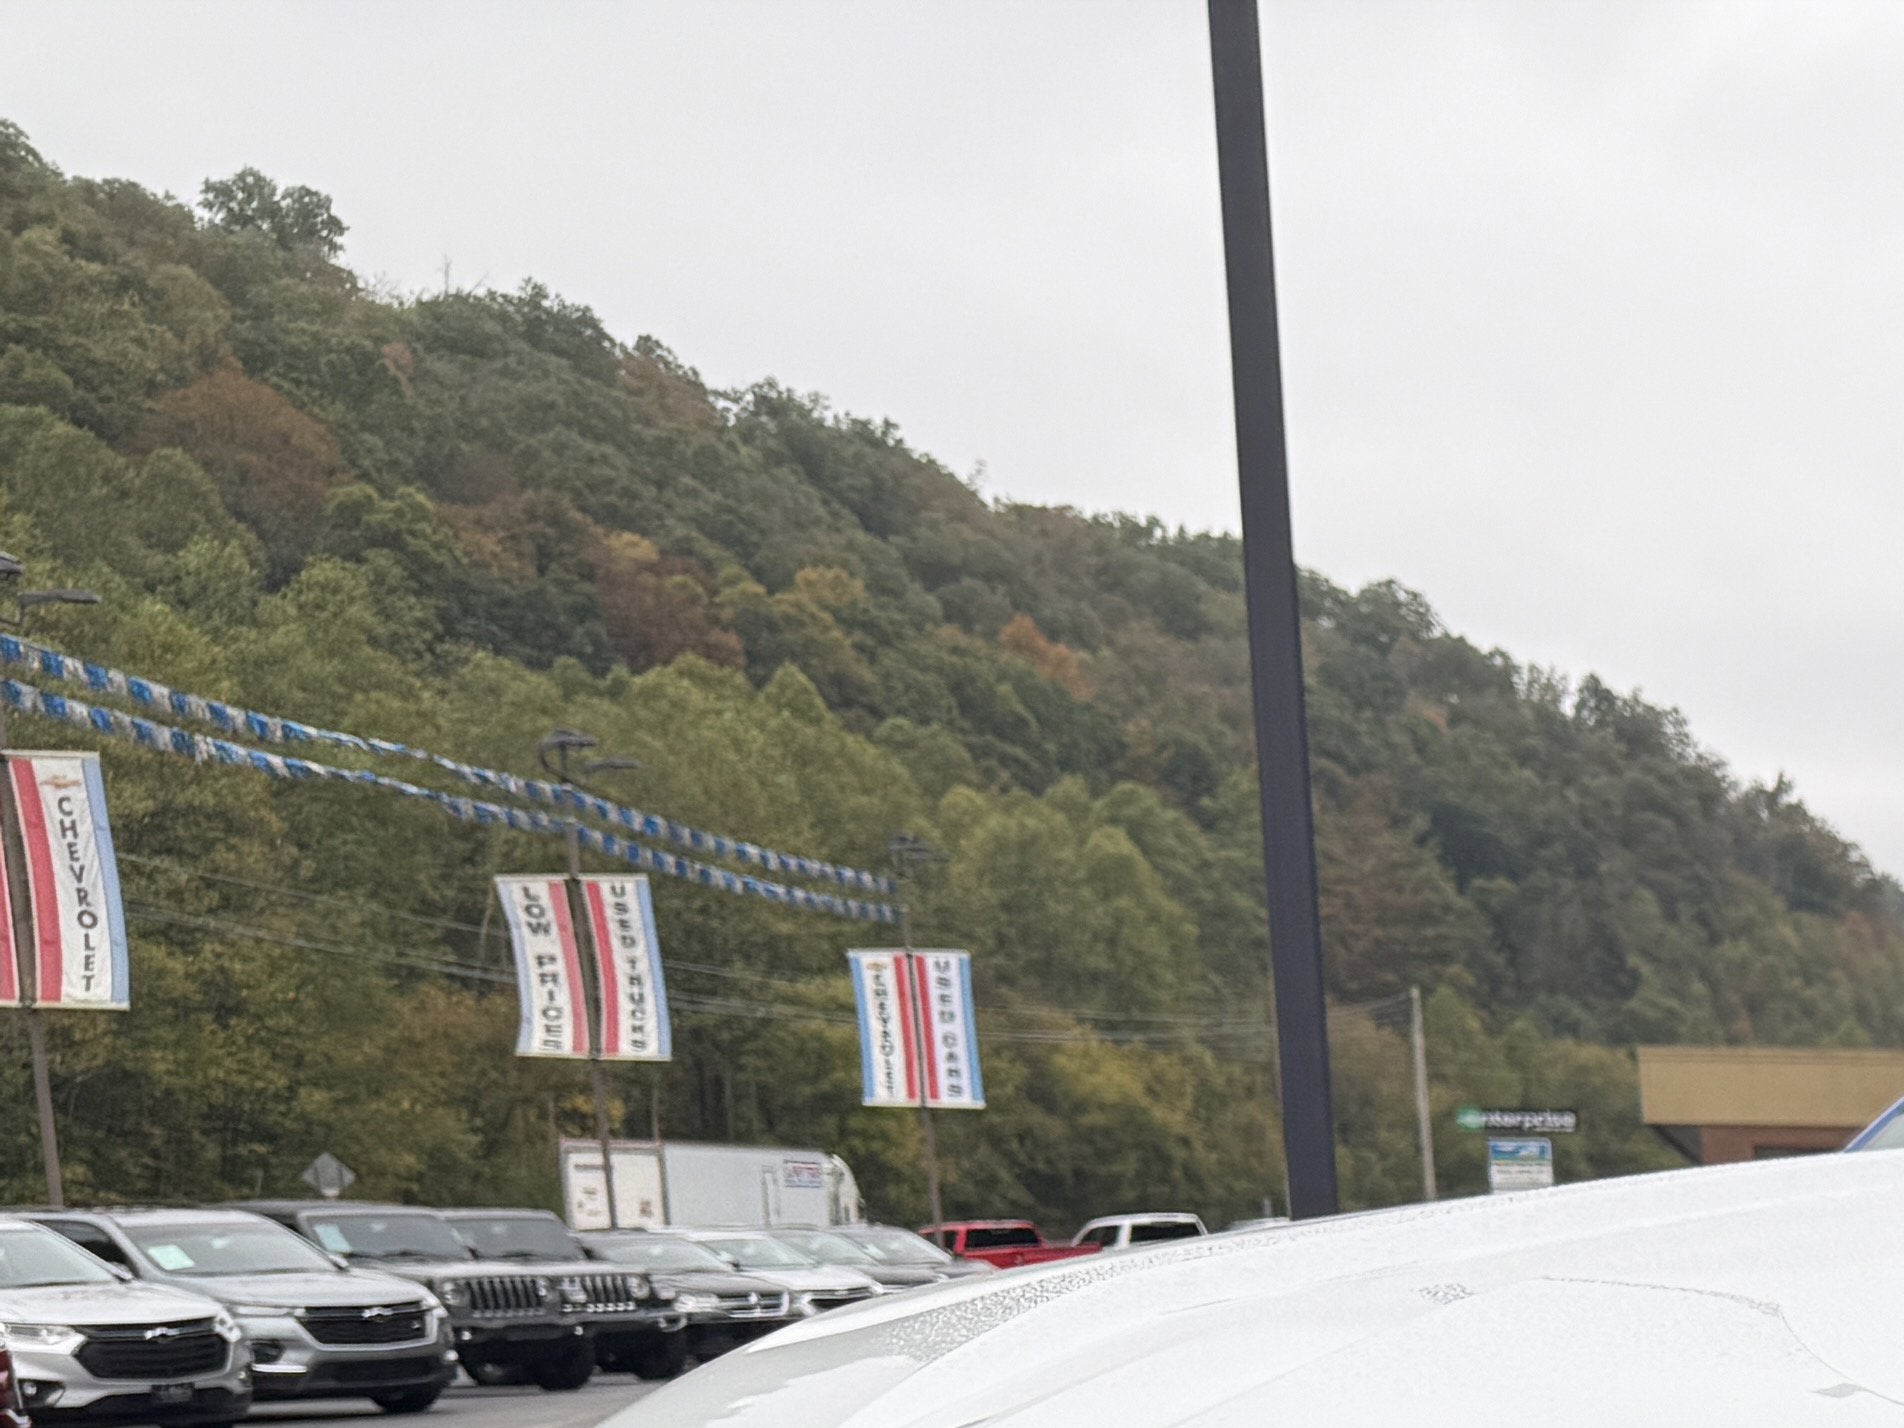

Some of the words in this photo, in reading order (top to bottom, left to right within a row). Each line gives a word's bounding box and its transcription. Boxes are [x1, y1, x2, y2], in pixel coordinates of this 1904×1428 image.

[57, 796, 98, 992] CHEVROLET
[522, 886, 550, 936] LOW
[611, 885, 635, 948] USED
